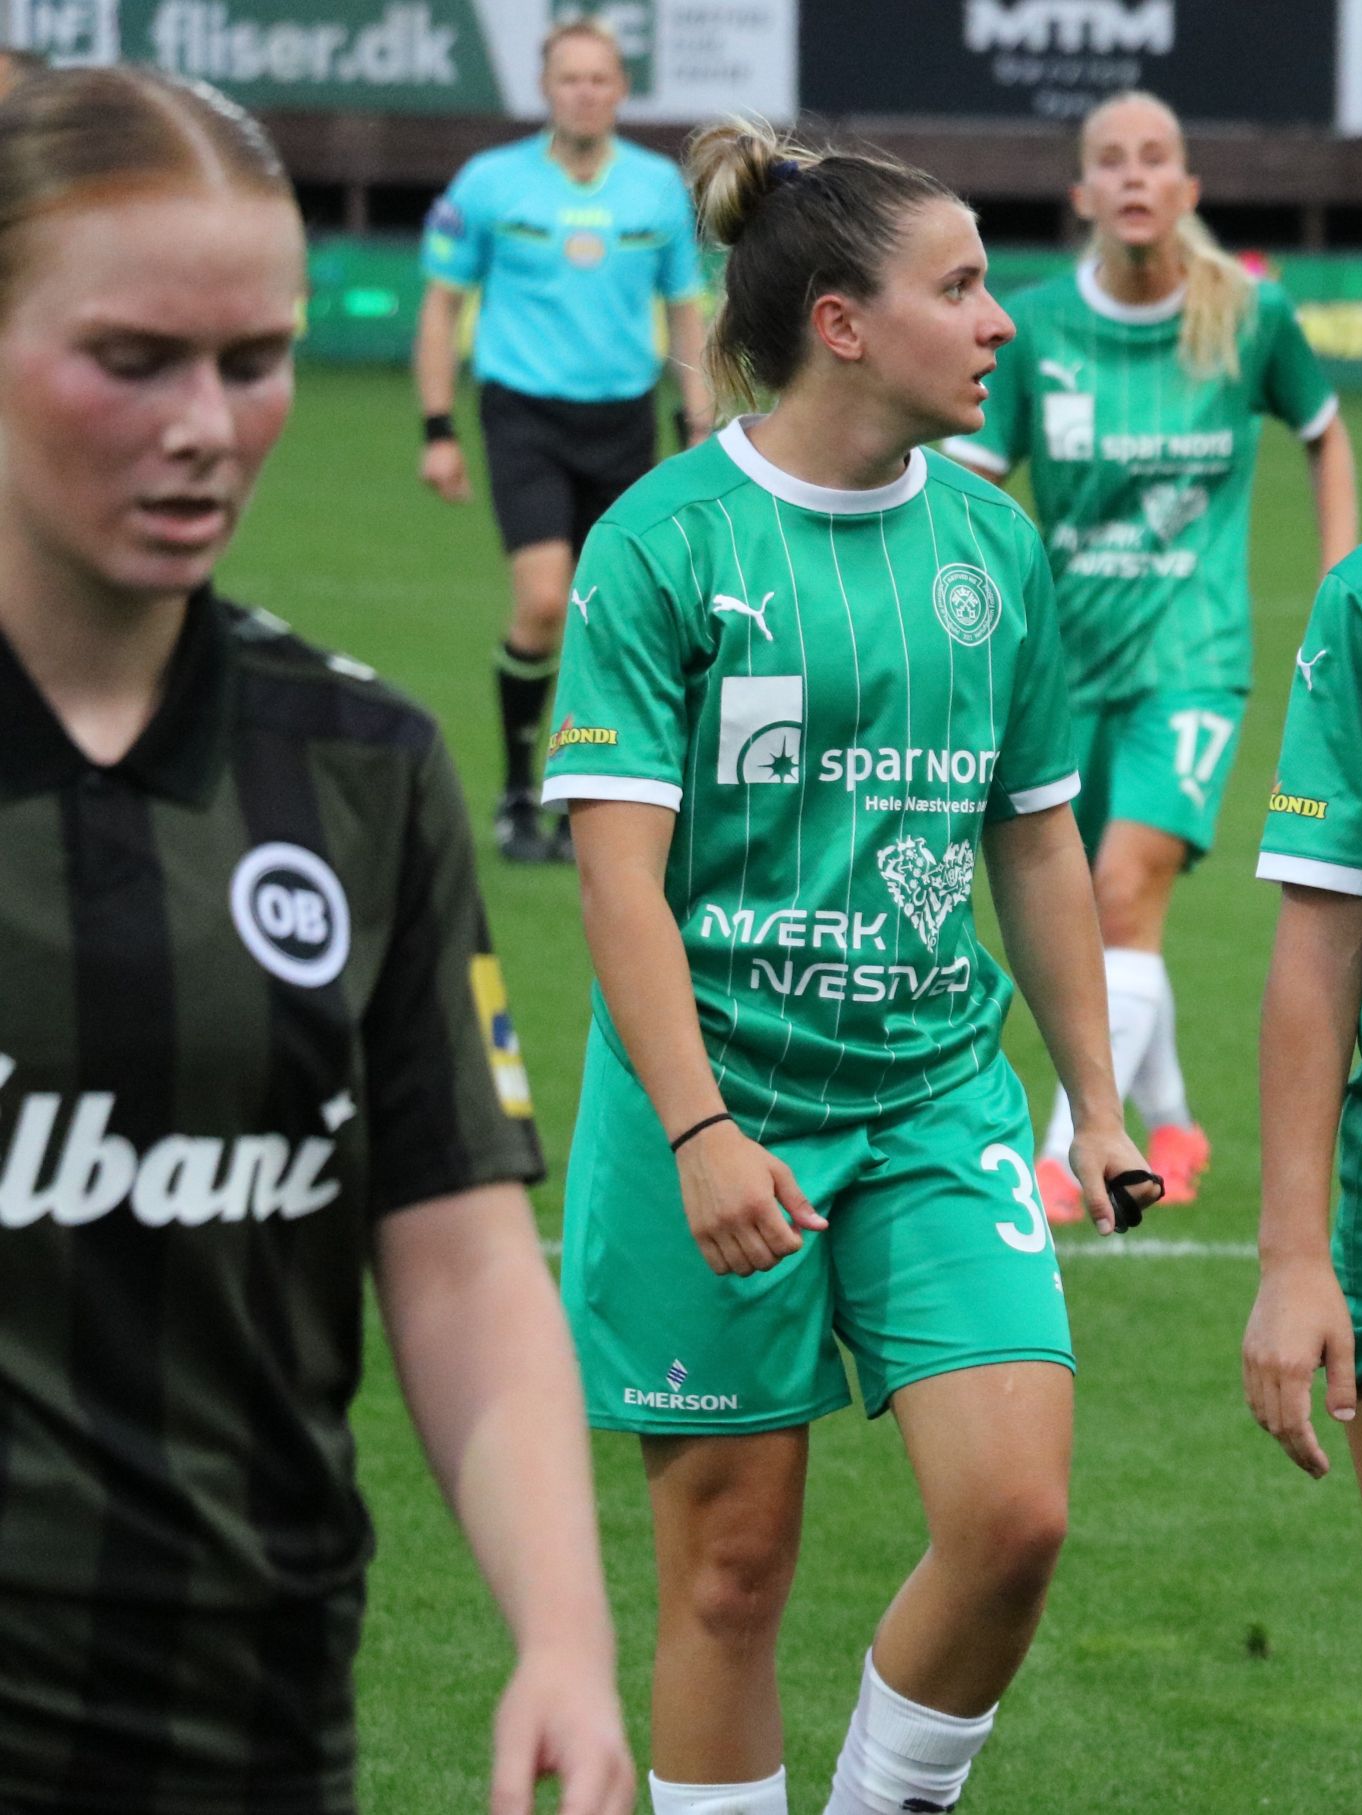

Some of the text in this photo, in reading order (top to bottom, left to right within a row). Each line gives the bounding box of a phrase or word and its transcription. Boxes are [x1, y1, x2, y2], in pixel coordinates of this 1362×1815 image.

[152, 0, 457, 83] fliser.dk
[965, 0, 1175, 54] MTM
[818, 747, 925, 792] spar
[1170, 710, 1234, 783] 17
[865, 795, 902, 811] Hele
[904, 796, 976, 813] Næstveds
[255, 882, 328, 944] OB
[0, 1053, 357, 1229] lbani
[980, 1142, 1047, 1253] 3
[623, 1387, 738, 1411] EMERSON
